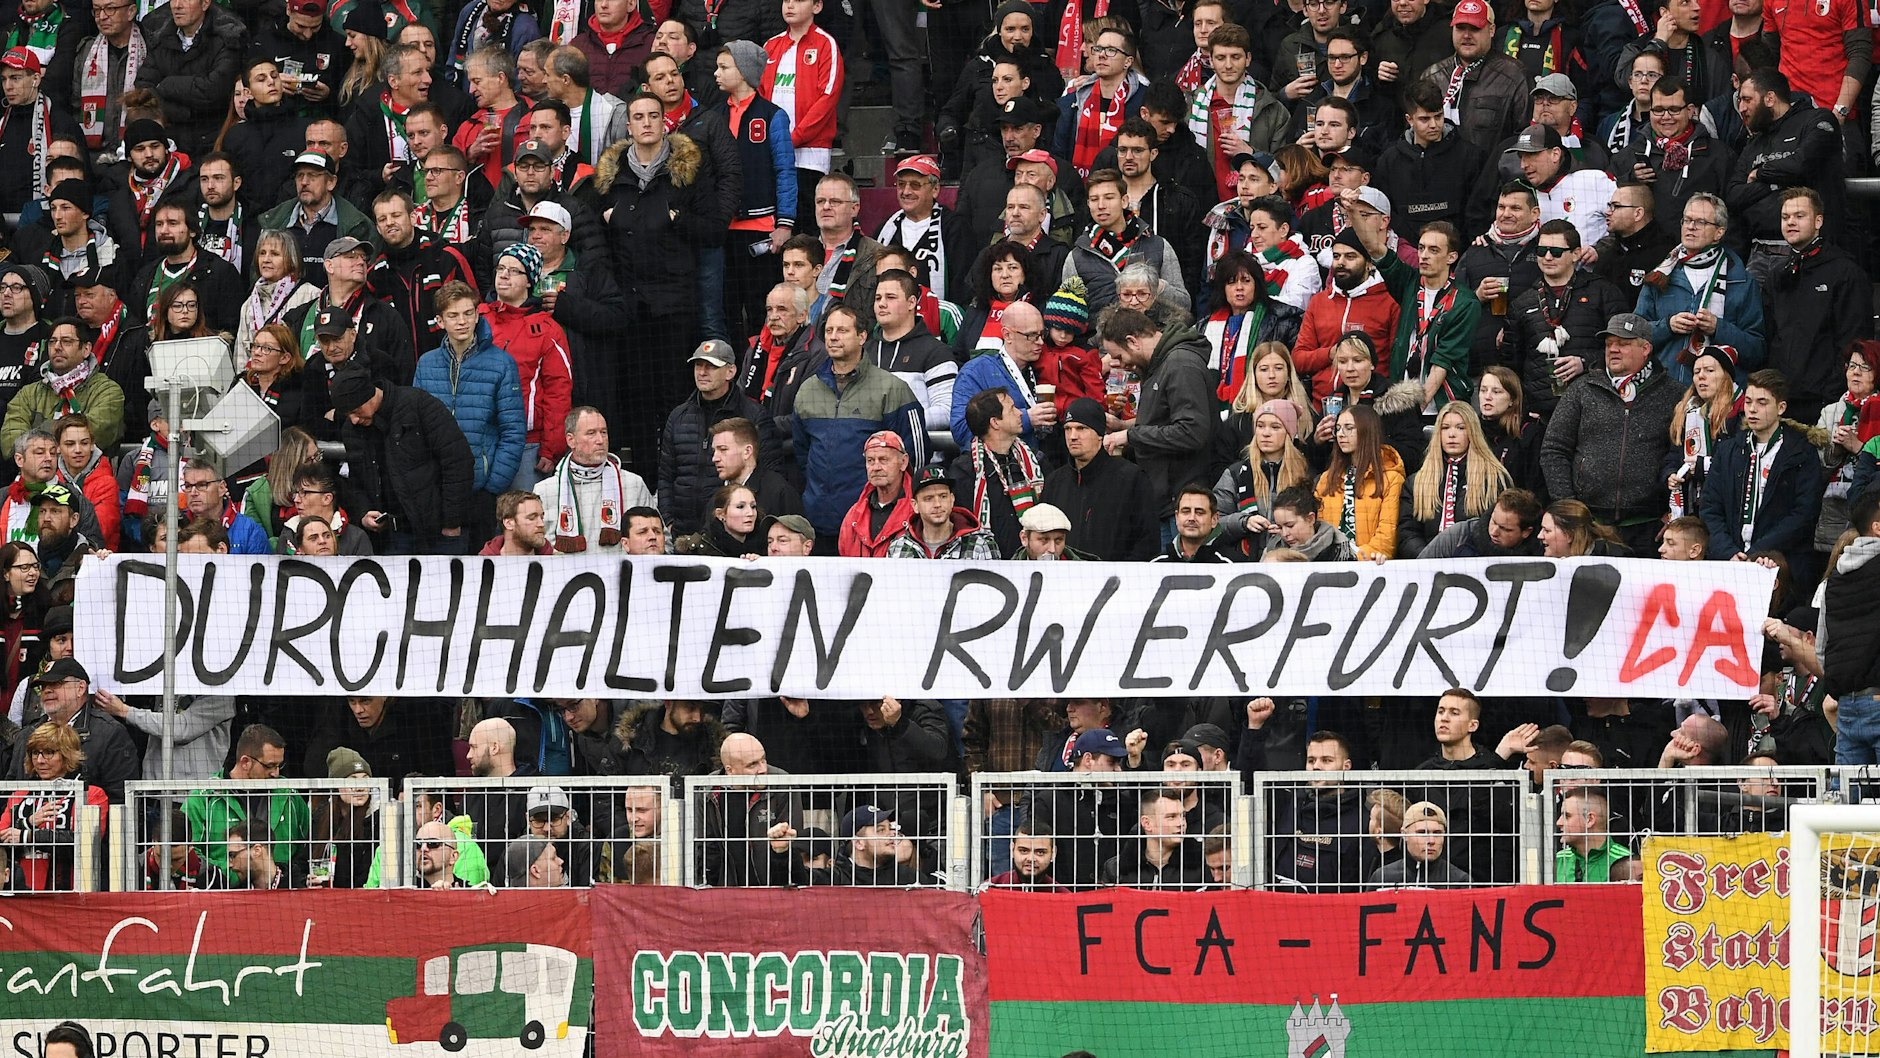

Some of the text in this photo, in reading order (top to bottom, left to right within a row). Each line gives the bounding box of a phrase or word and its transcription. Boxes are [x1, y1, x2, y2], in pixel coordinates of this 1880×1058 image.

[922, 468, 945, 479] AUX
[114, 558, 1622, 694] DURCHHALTEN RW ERFURT!
[1657, 847, 1791, 915] Frei
[0, 910, 323, 1006] anfahrt
[1076, 903, 1235, 976] FCA
[1359, 898, 1565, 977] FANS
[632, 950, 971, 1037] CONCORDIA
